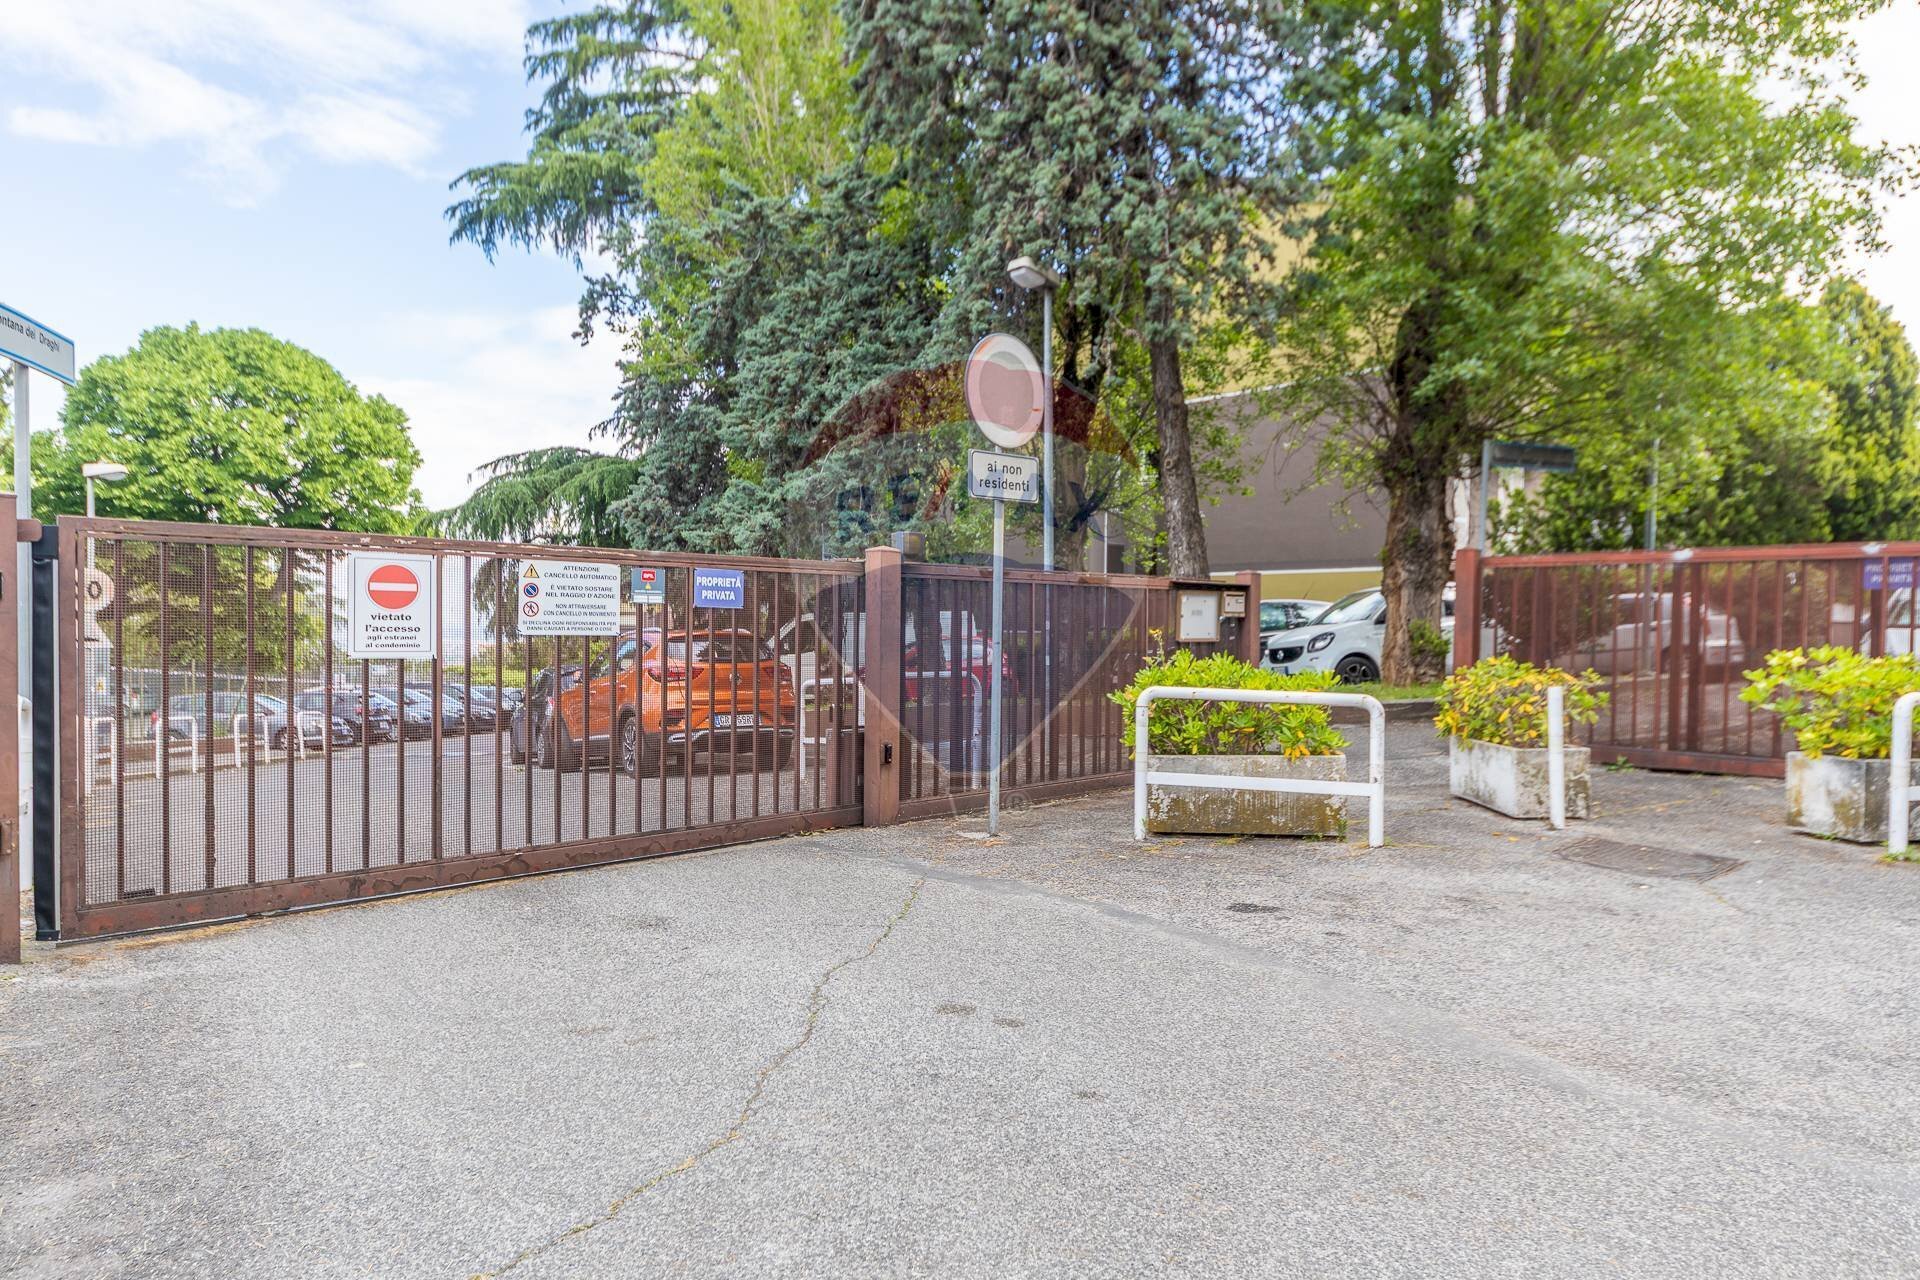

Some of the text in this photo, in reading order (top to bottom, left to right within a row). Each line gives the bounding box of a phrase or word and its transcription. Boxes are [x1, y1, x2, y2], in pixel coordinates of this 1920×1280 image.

[39, 332, 60, 352] Draghi
[987, 461, 1022, 475] ai non
[979, 477, 1030, 492] residenti
[696, 576, 741, 588] PROPRIETÀ
[701, 590, 736, 601] PRIVATA
[370, 613, 412, 621] vietato
